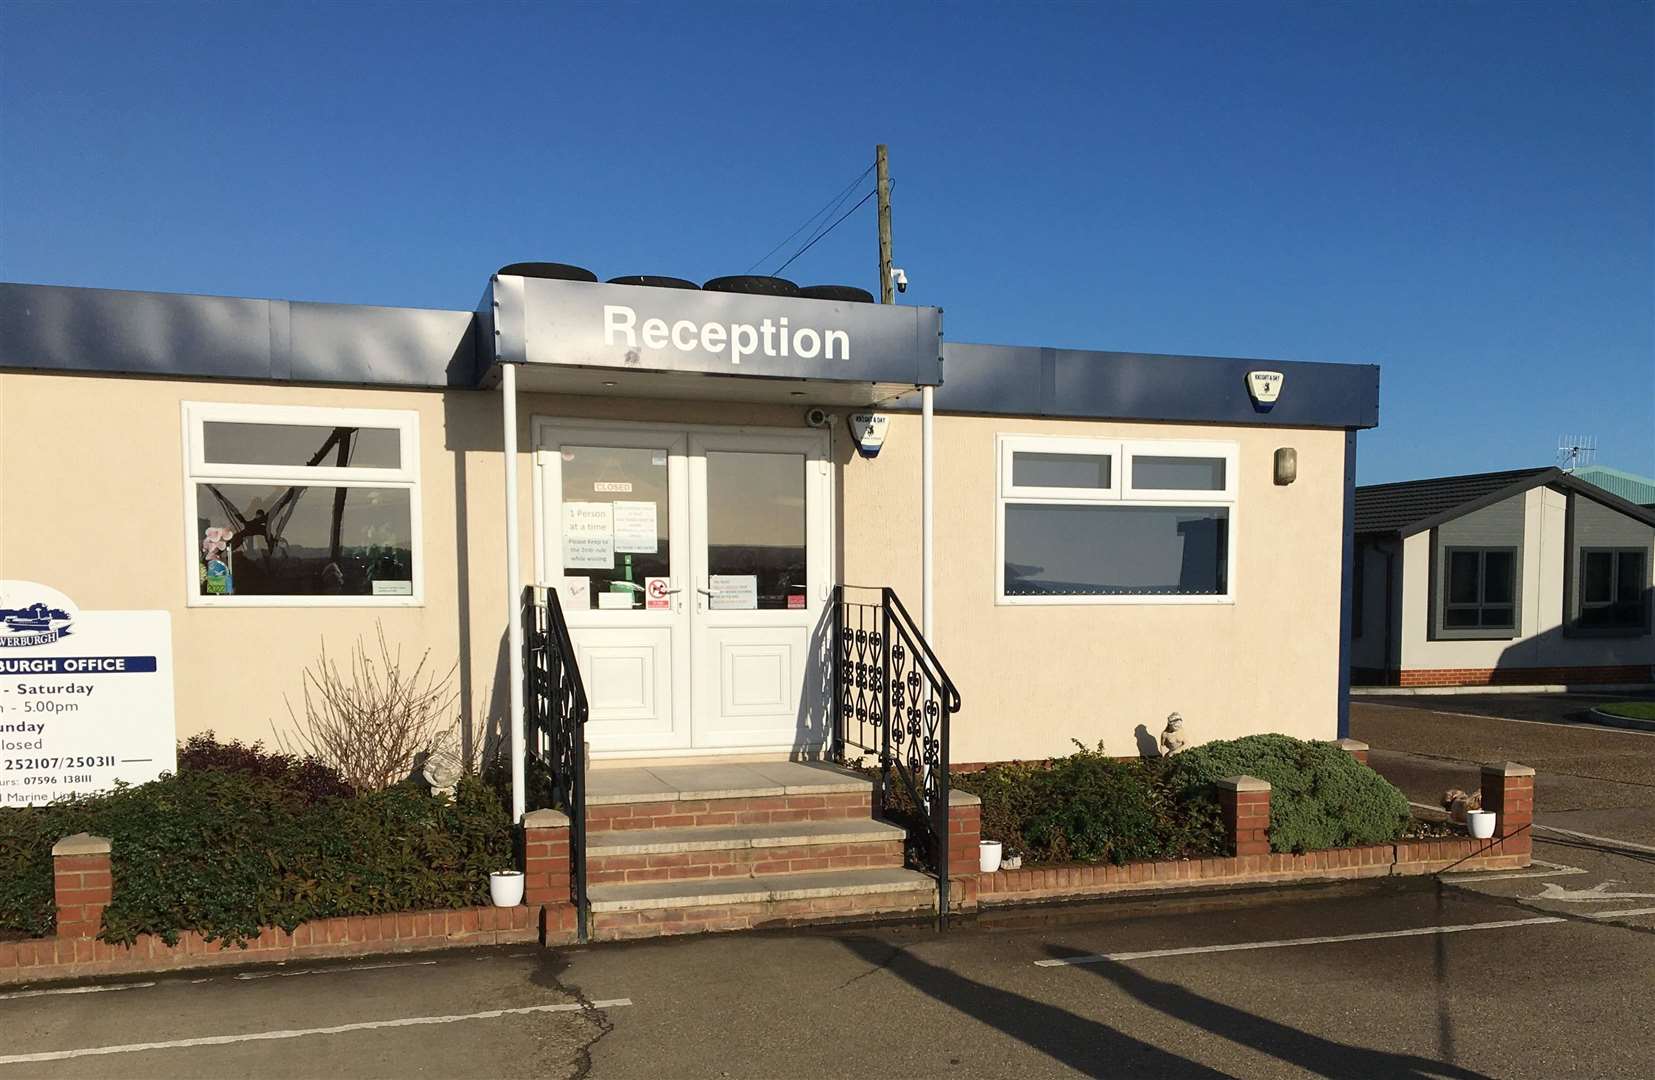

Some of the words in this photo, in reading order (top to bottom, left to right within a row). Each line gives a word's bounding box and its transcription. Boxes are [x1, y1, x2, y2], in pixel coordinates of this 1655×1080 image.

[603, 304, 850, 364] Reception
[596, 483, 631, 491] CLOSED
[569, 509, 575, 518] 1
[577, 509, 606, 519] Person
[569, 523, 578, 531] at
[587, 523, 607, 531] time
[64, 659, 125, 671] OFFICE
[17, 683, 94, 696] Saturday
[24, 700, 79, 715] 5.00pm
[5, 756, 116, 770] 252107/250311
[24, 776, 57, 785] 07596
[63, 774, 92, 784] 138111
[8, 792, 48, 802] Marine
